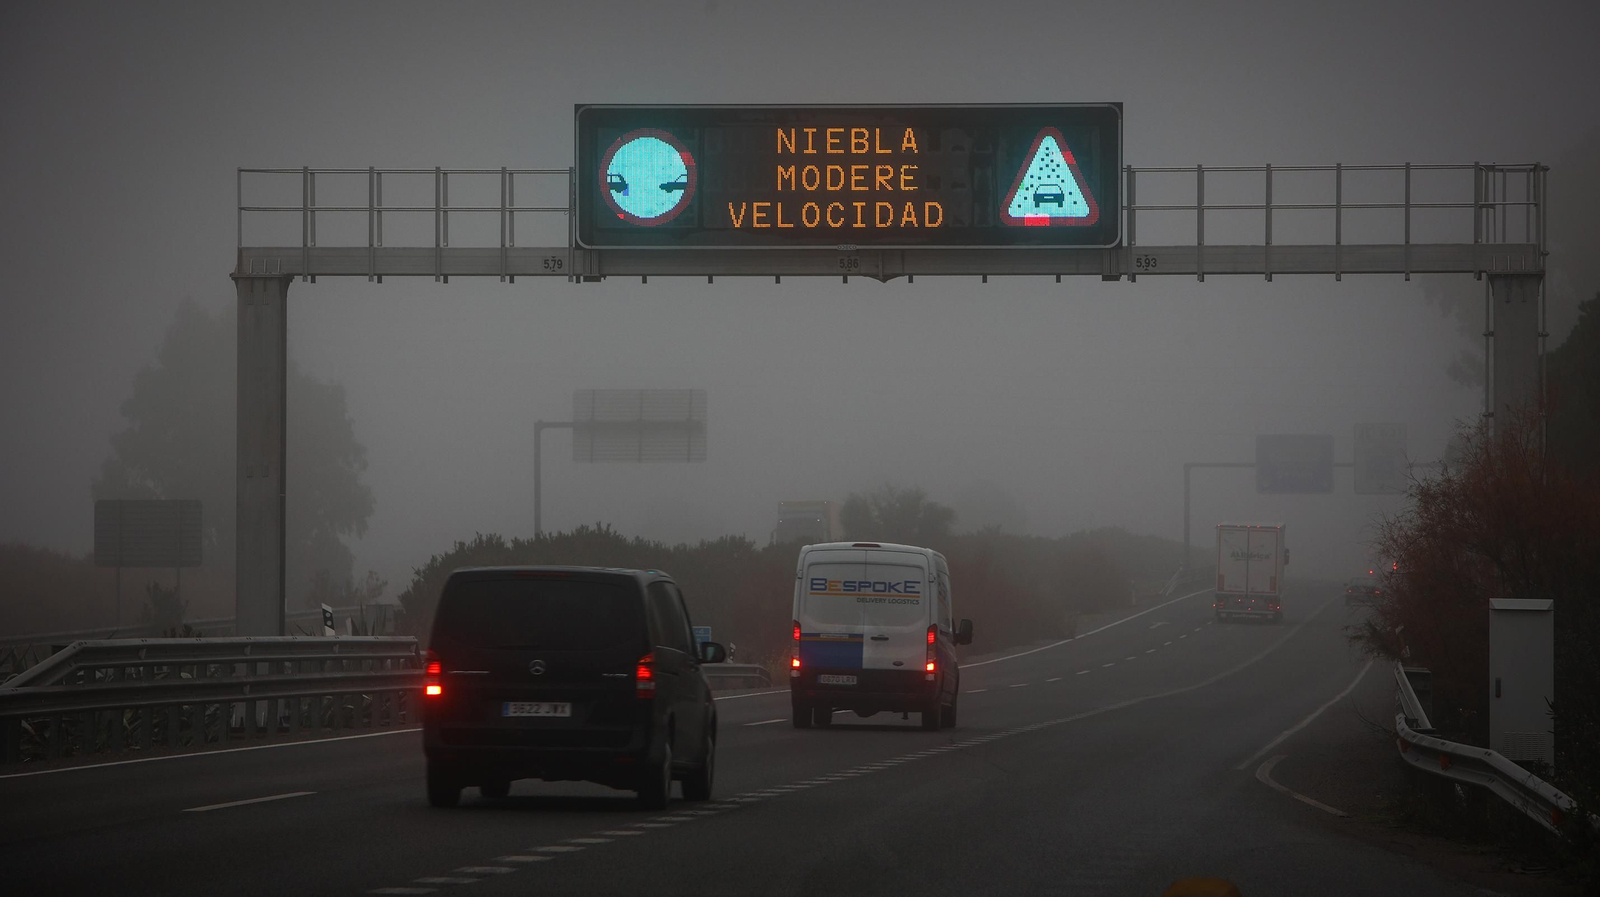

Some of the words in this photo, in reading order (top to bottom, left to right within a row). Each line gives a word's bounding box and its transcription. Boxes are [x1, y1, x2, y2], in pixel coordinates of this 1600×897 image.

[776, 127, 920, 155] NIEBLA
[728, 201, 945, 228] VELOCIDAD
[543, 258, 563, 270] 5,79
[839, 258, 859, 269] 5,86
[1136, 257, 1157, 269] 5,93
[810, 577, 921, 594] BESPOKE
[857, 597, 887, 605] DELIVERY
